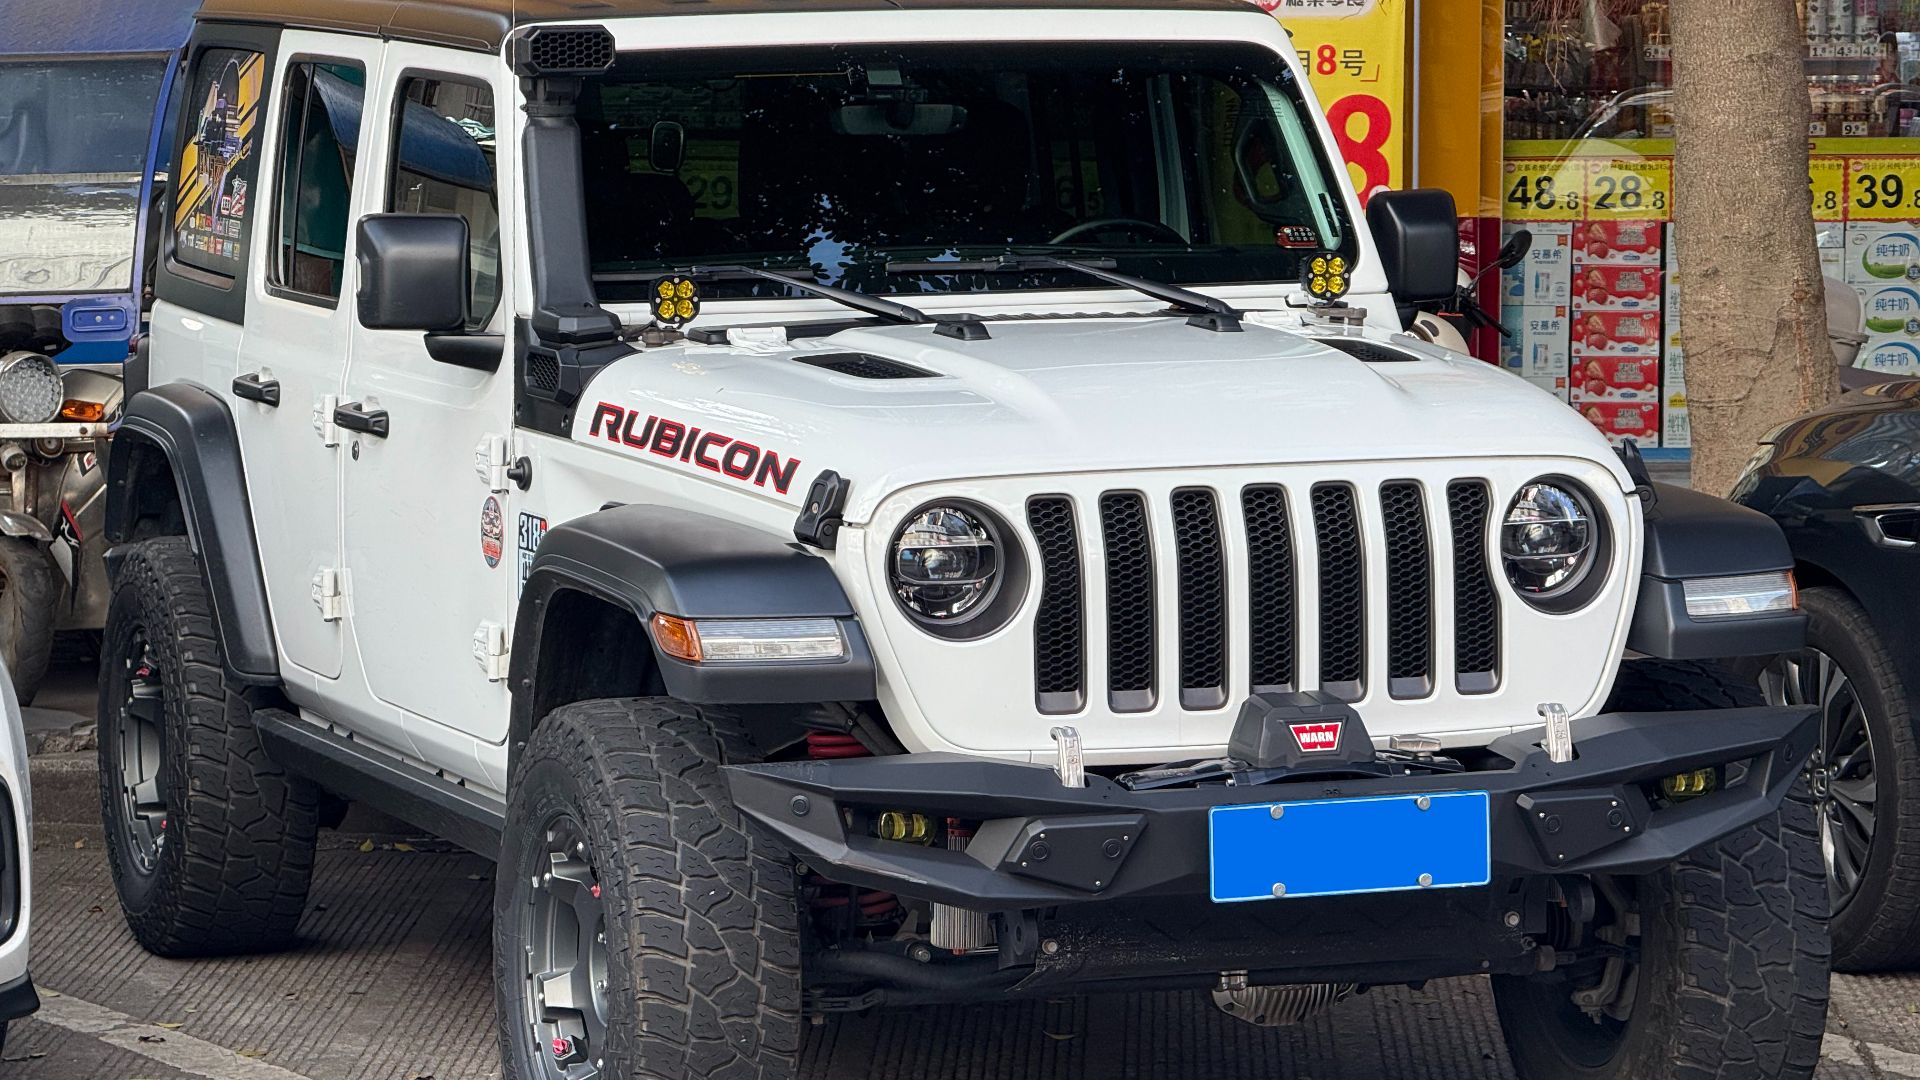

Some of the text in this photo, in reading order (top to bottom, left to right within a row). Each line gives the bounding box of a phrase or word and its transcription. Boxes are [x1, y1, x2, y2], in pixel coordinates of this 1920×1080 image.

[1507, 175, 1579, 210] 48.8
[1594, 175, 1665, 210] 28.8
[1808, 176, 1837, 210] .8
[1856, 174, 1920, 209] 39.8
[1532, 249, 1562, 260] 安慕希
[1876, 243, 1910, 257] 纯牛奶
[1875, 297, 1910, 311] 纯牛奶
[1530, 320, 1561, 331] 安慕希
[1874, 352, 1909, 367] 纯牛奶
[588, 401, 802, 495] RUBICON
[1300, 731, 1335, 743] WARN
